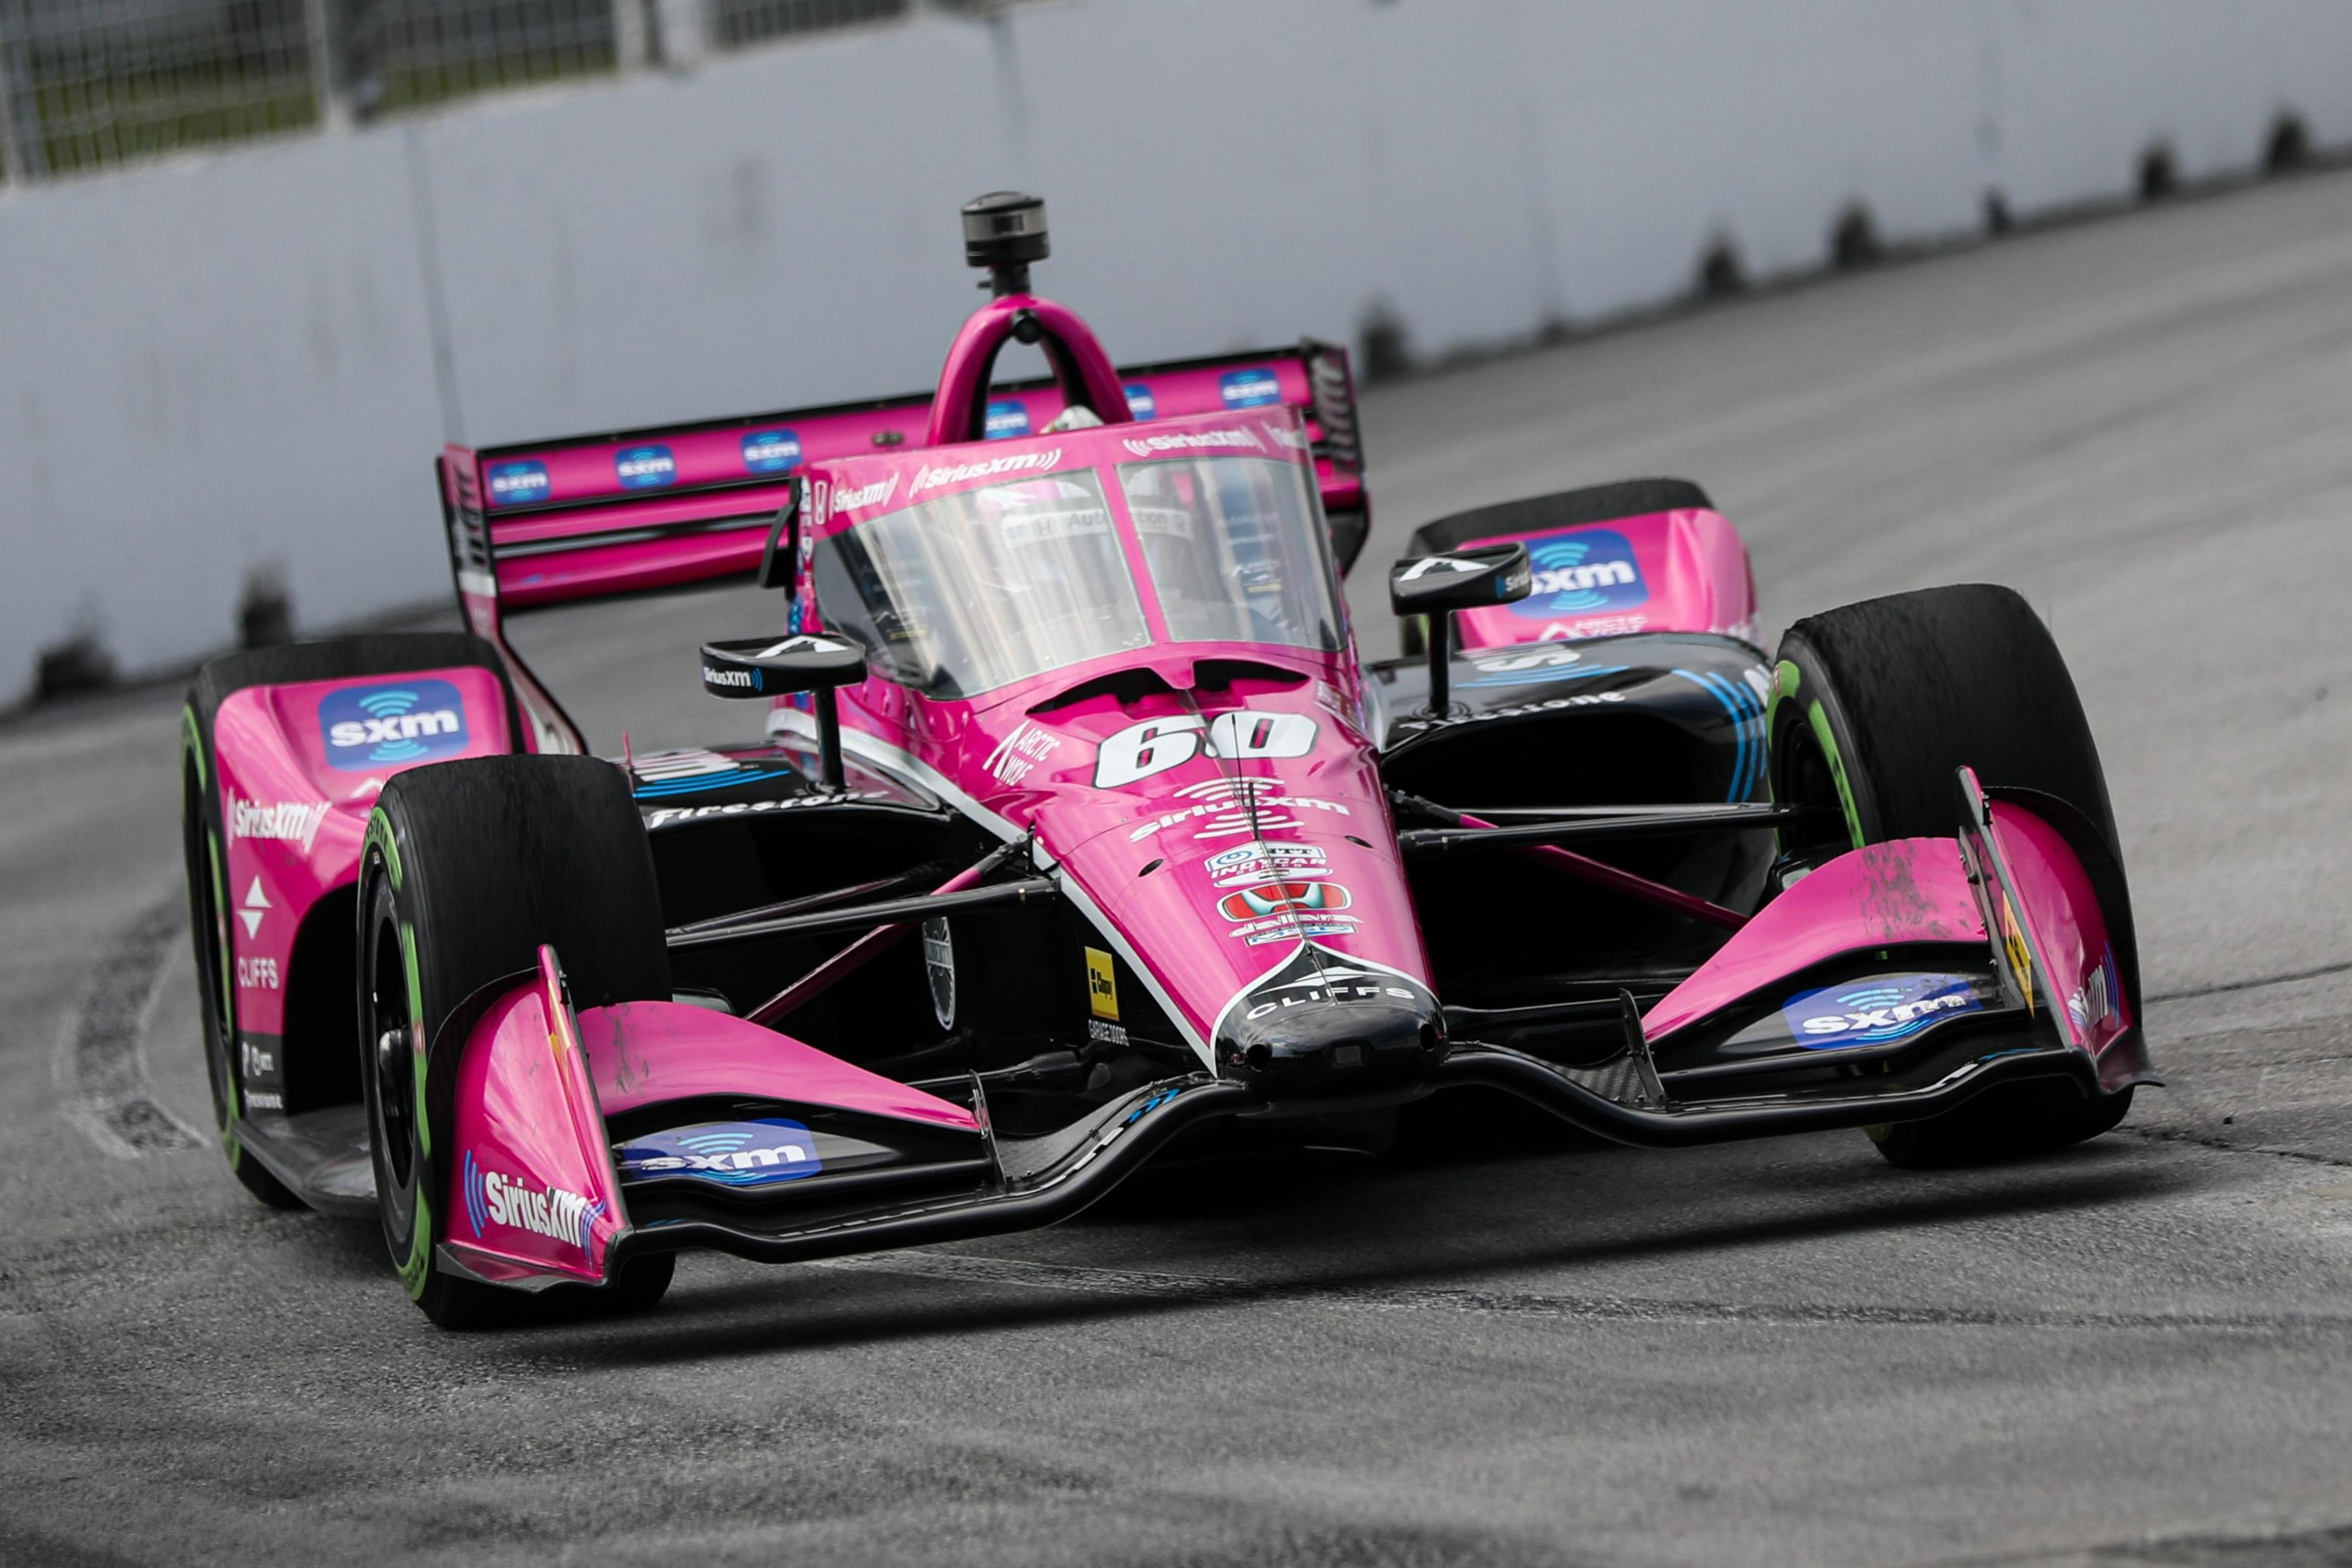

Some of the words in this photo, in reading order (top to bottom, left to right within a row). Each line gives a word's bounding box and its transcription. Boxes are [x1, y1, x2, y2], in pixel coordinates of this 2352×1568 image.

[618, 457, 674, 476] sxm
[744, 441, 799, 461] sxm
[330, 709, 460, 747] sxm
[1014, 727, 1061, 762] ARCTIC
[1095, 711, 1315, 787] 60
[999, 755, 1034, 786] WOLF
[1211, 857, 1327, 879] INDYCAR
[237, 957, 279, 989] CLIFFS
[1246, 987, 1415, 1020] CLIFFS
[640, 1144, 807, 1172] sxm
